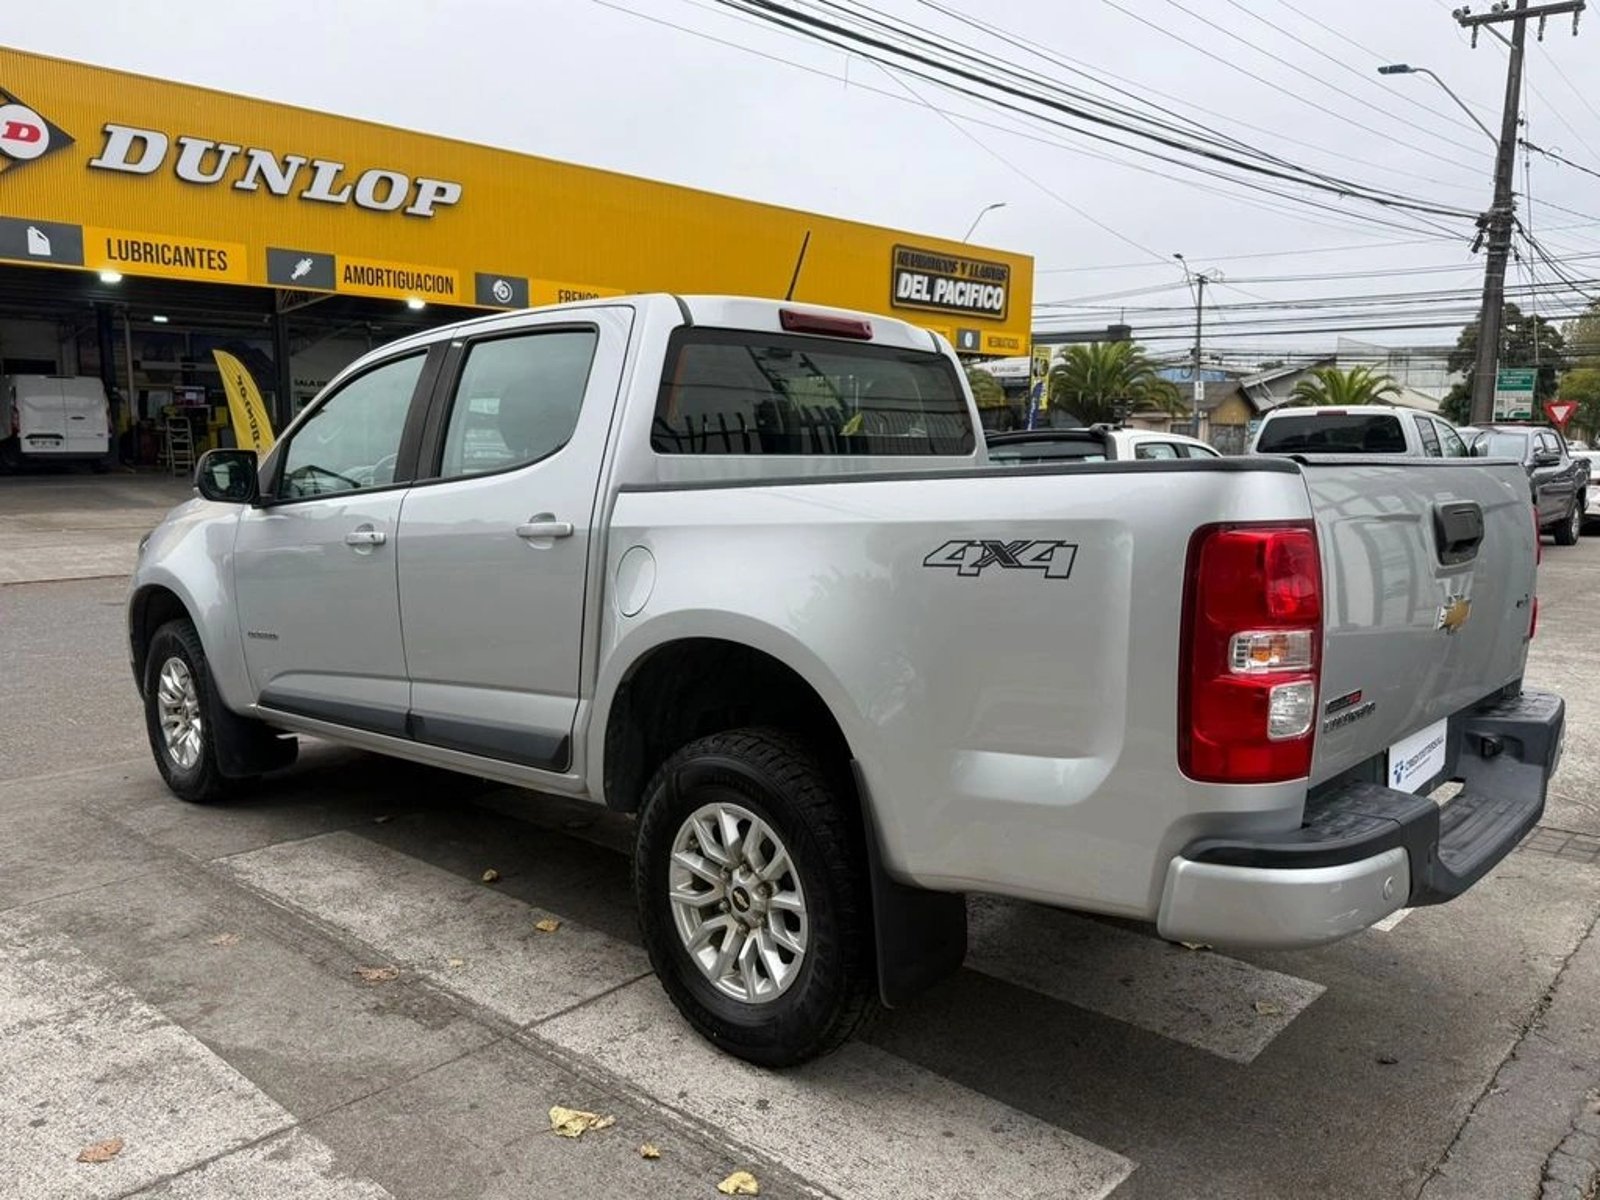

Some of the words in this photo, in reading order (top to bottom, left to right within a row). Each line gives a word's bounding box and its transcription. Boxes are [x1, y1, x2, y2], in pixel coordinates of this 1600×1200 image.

[1, 121, 41, 143] D
[89, 123, 463, 218] DUNLOP
[106, 238, 228, 272] LUBRICANTES
[343, 264, 454, 295] AMORTIGUACION
[897, 272, 931, 301] DEL
[932, 278, 1004, 311] PACIFICO
